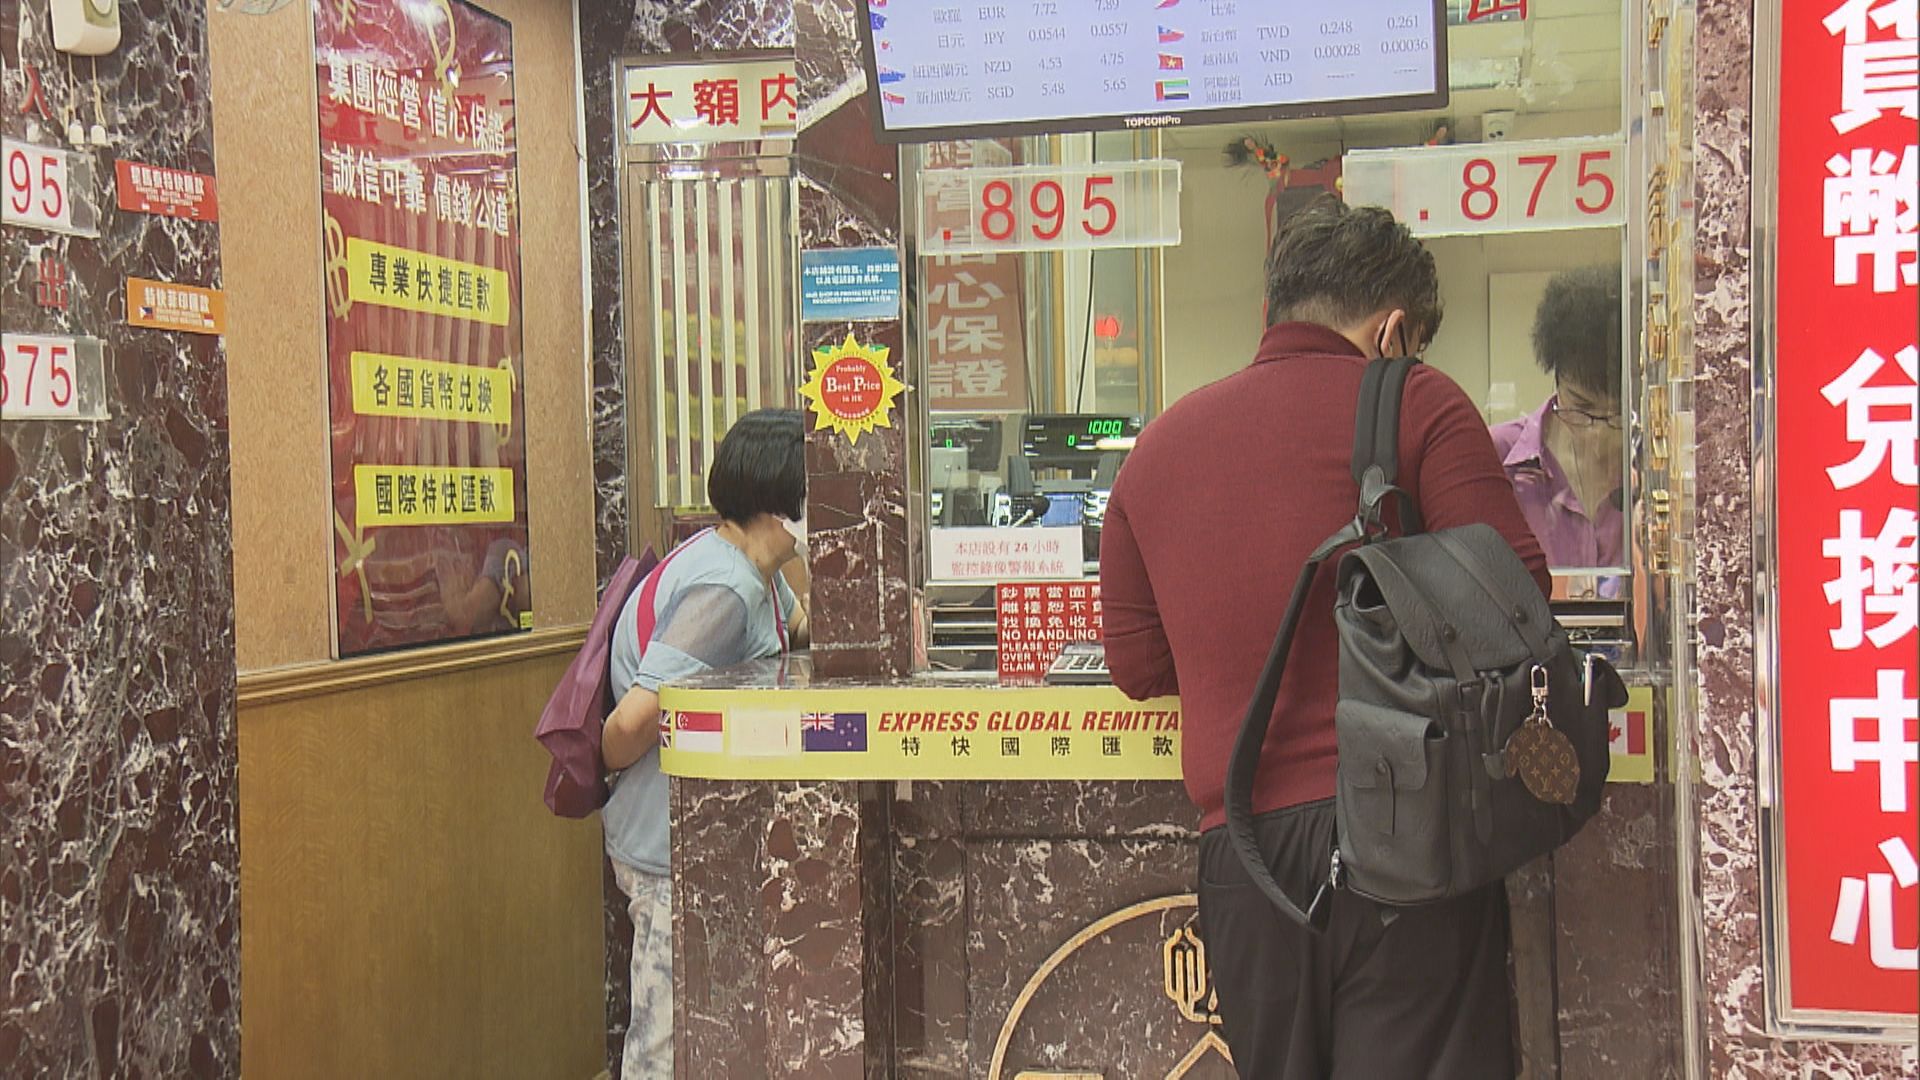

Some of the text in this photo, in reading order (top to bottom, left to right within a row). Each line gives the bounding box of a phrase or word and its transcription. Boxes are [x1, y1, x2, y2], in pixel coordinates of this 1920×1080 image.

[978, 6, 1006, 21] EUR
[1033, 3, 1057, 16] 7.72
[1095, 0, 1120, 11] 7.89
[938, 22, 1128, 49] 日元 JPY 0.0544 0.0557
[1258, 25, 1290, 41] TWD
[1320, 21, 1353, 35] 0.248
[1387, 16, 1419, 30] 0.261
[1260, 48, 1290, 63] VND
[1314, 44, 1361, 59] 0.00028
[1381, 38, 1429, 54] 0.00036
[984, 60, 1012, 74] NZD
[1038, 57, 1062, 70] 4.53
[1100, 52, 1124, 66] 4.75
[987, 86, 1014, 99] SGD
[1042, 82, 1065, 96] 5.48
[1104, 77, 1127, 92] 5.65
[1264, 73, 1293, 87] AED
[21, 64, 52, 121] 入
[328, 49, 507, 158] 集團經營 信心保證
[330, 141, 509, 238] 誠信可靠 價錢公道
[1419, 151, 1615, 222] .875
[943, 177, 1117, 241] .895
[39, 256, 67, 311] 出
[369, 251, 491, 312] 專業快捷匯款
[836, 364, 867, 373] Probably
[372, 364, 493, 414] 各國貨幣兌換
[826, 376, 880, 393] Best Price
[1088, 420, 1123, 435] 1000
[1067, 434, 1076, 447] 0
[375, 473, 496, 516] 國際特快匯款
[1015, 543, 1029, 553] 24
[1033, 540, 1060, 554] 小時
[1001, 629, 1098, 641] NO HANDLING
[1002, 642, 1063, 652] PLEASE CH
[1002, 652, 1031, 662] OVER
[1002, 663, 1035, 672] CLAIM
[877, 711, 1180, 732] EXPRESS GLOBAL REMITTA
[901, 735, 1174, 756] 特快國際匯款
